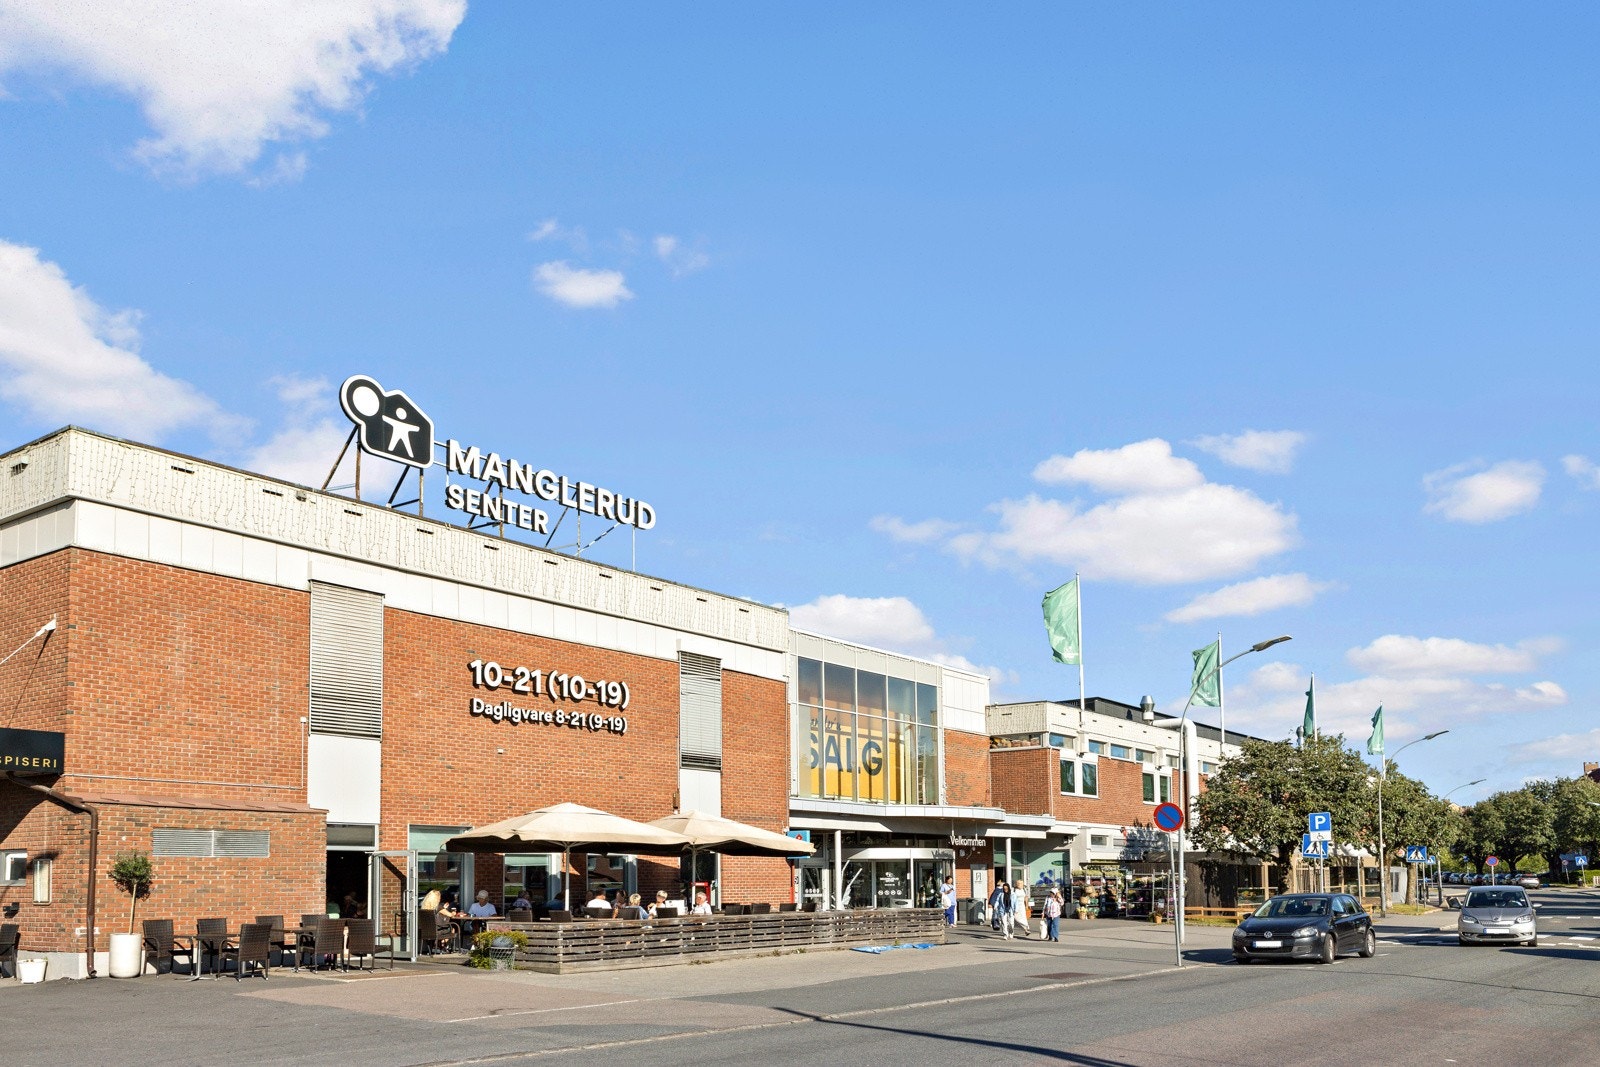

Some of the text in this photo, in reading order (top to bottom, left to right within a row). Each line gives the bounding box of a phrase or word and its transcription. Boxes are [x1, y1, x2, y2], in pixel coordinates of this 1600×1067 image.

[447, 439, 657, 530] MANGLERUD
[446, 484, 549, 534] SENTER
[470, 659, 630, 709] 10-21 (10-19)
[472, 698, 628, 733] Dagligvare 8-21 (9-19)
[0, 755, 57, 768] PISERI
[1314, 815, 1326, 830] P
[950, 835, 986, 847] Velkommen
